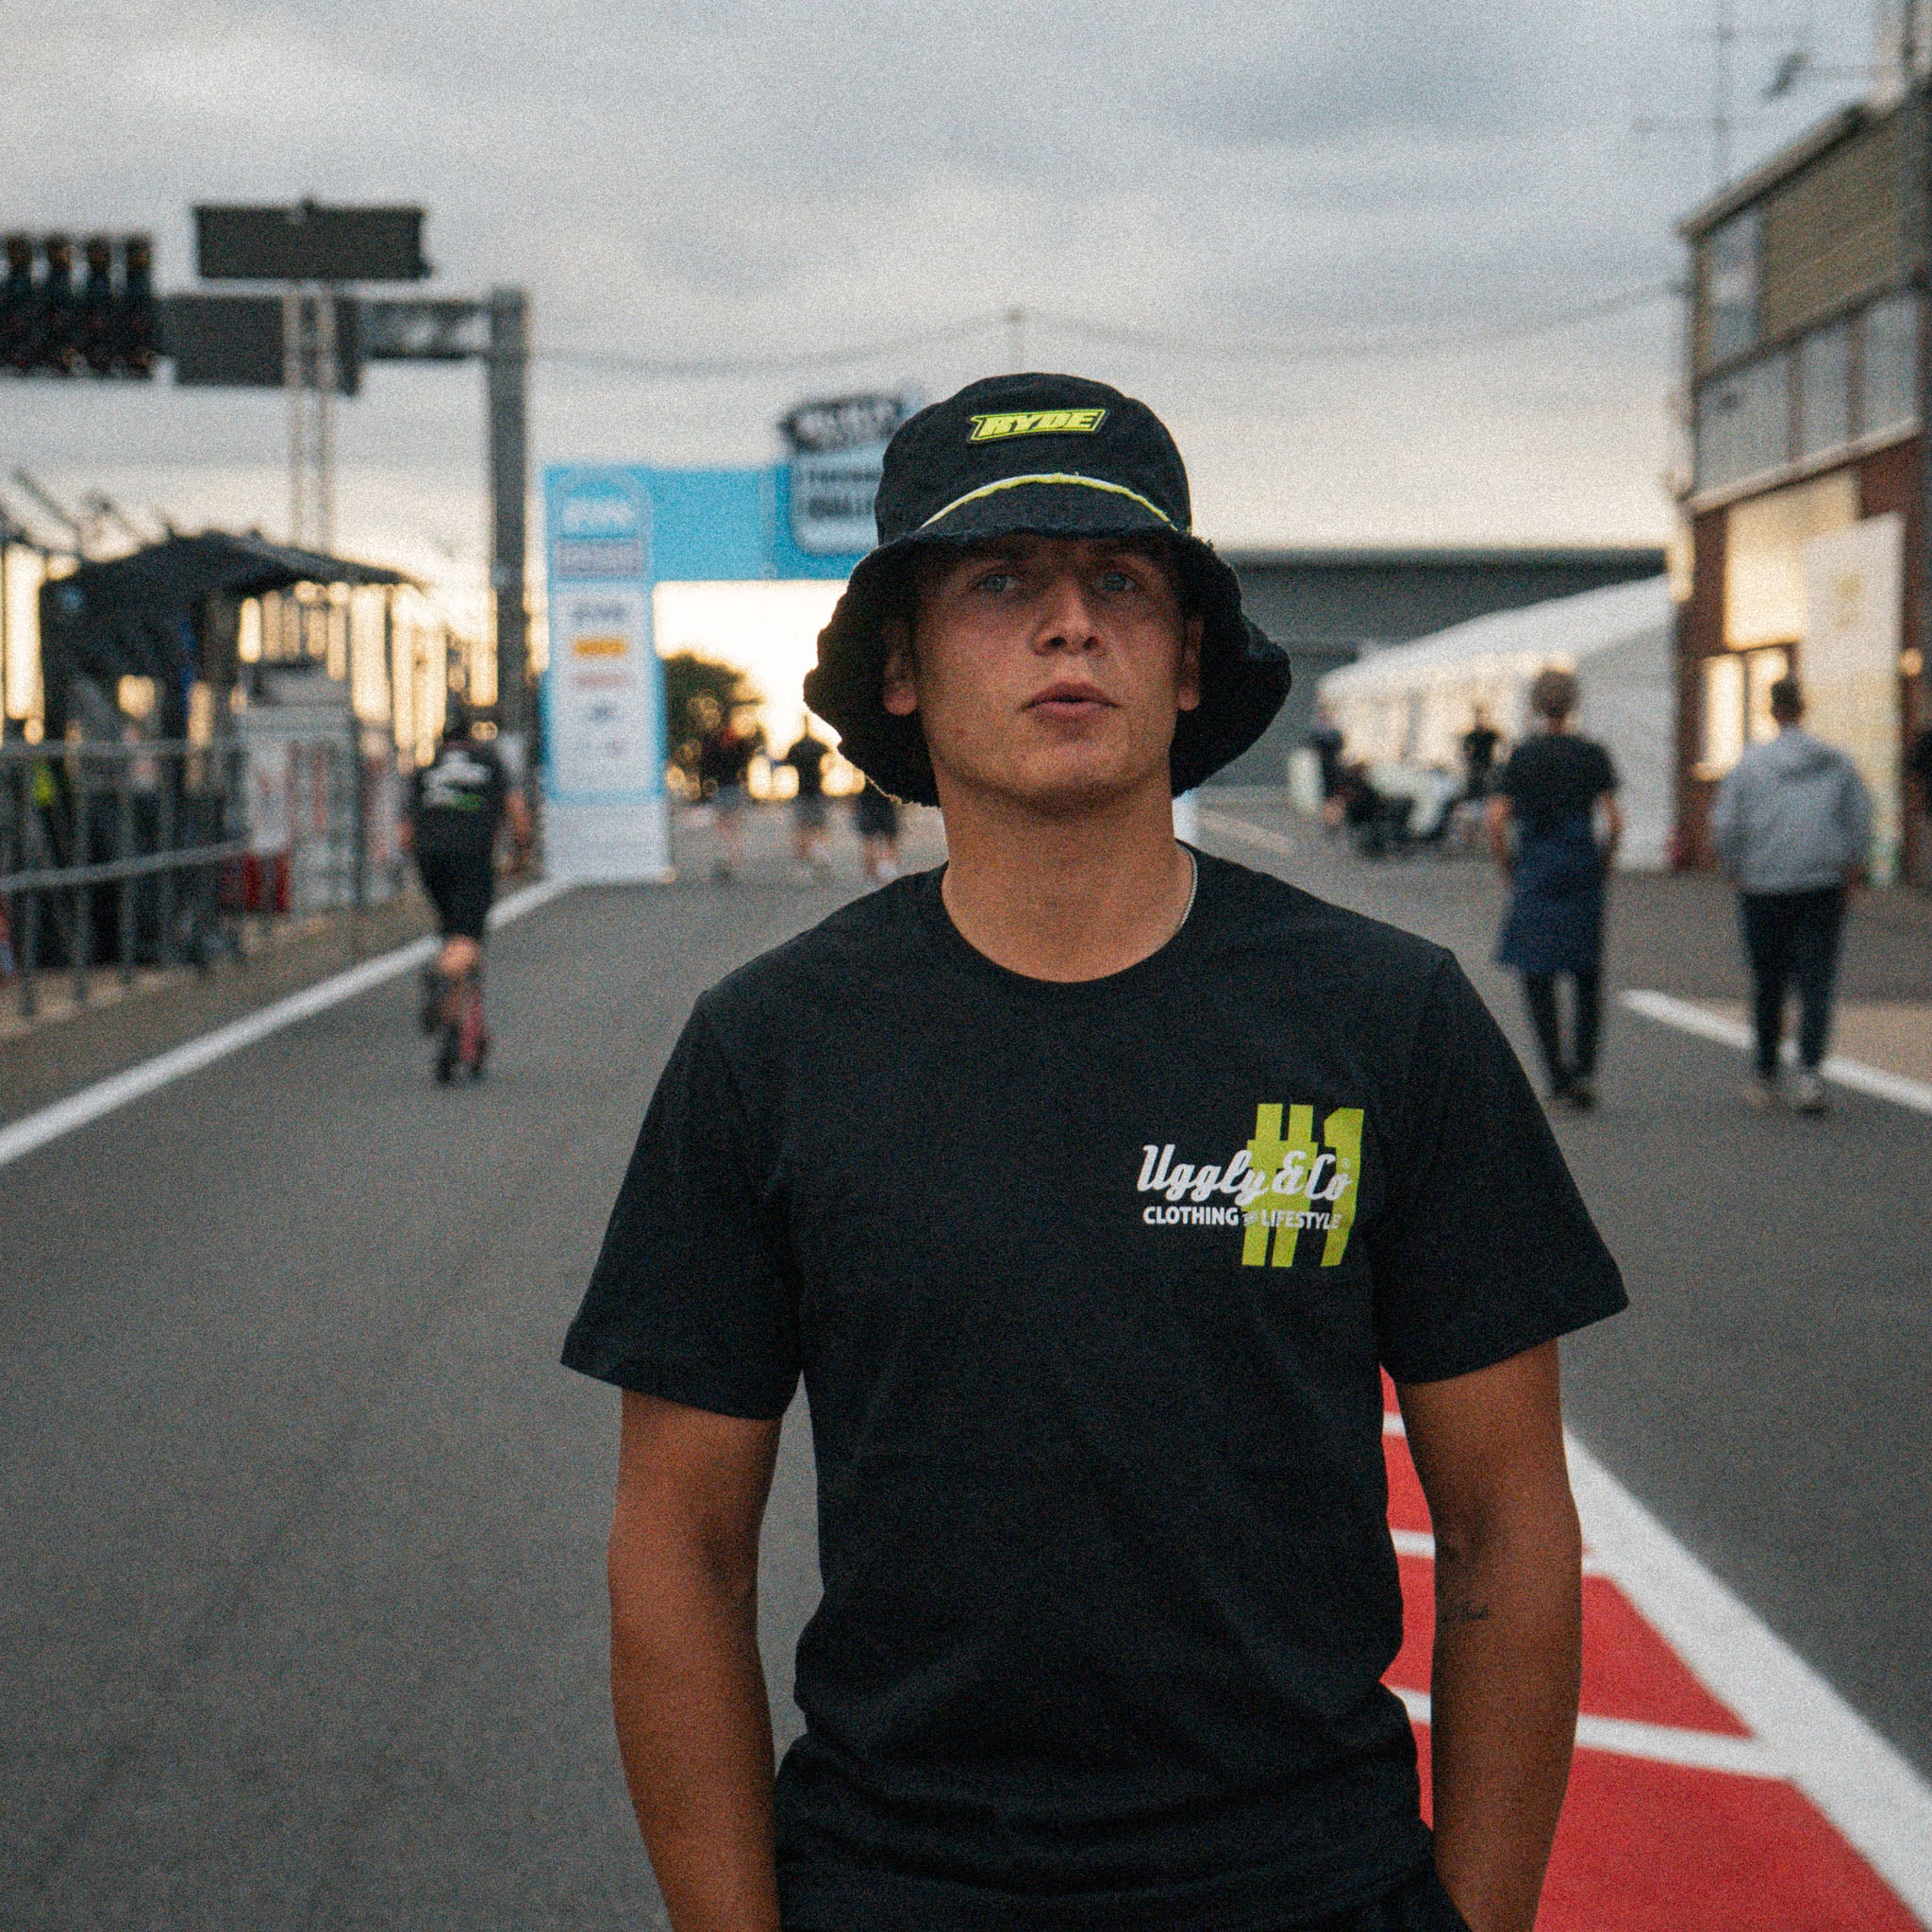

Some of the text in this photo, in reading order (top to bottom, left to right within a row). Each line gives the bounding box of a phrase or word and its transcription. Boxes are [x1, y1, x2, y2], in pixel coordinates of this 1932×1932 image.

[976, 410, 1100, 438] RYDE
[1137, 1143, 1269, 1206] Uggly
[1142, 1206, 1239, 1225] CLOTHING
[1261, 1209, 1342, 1230] LIFESTYLE
